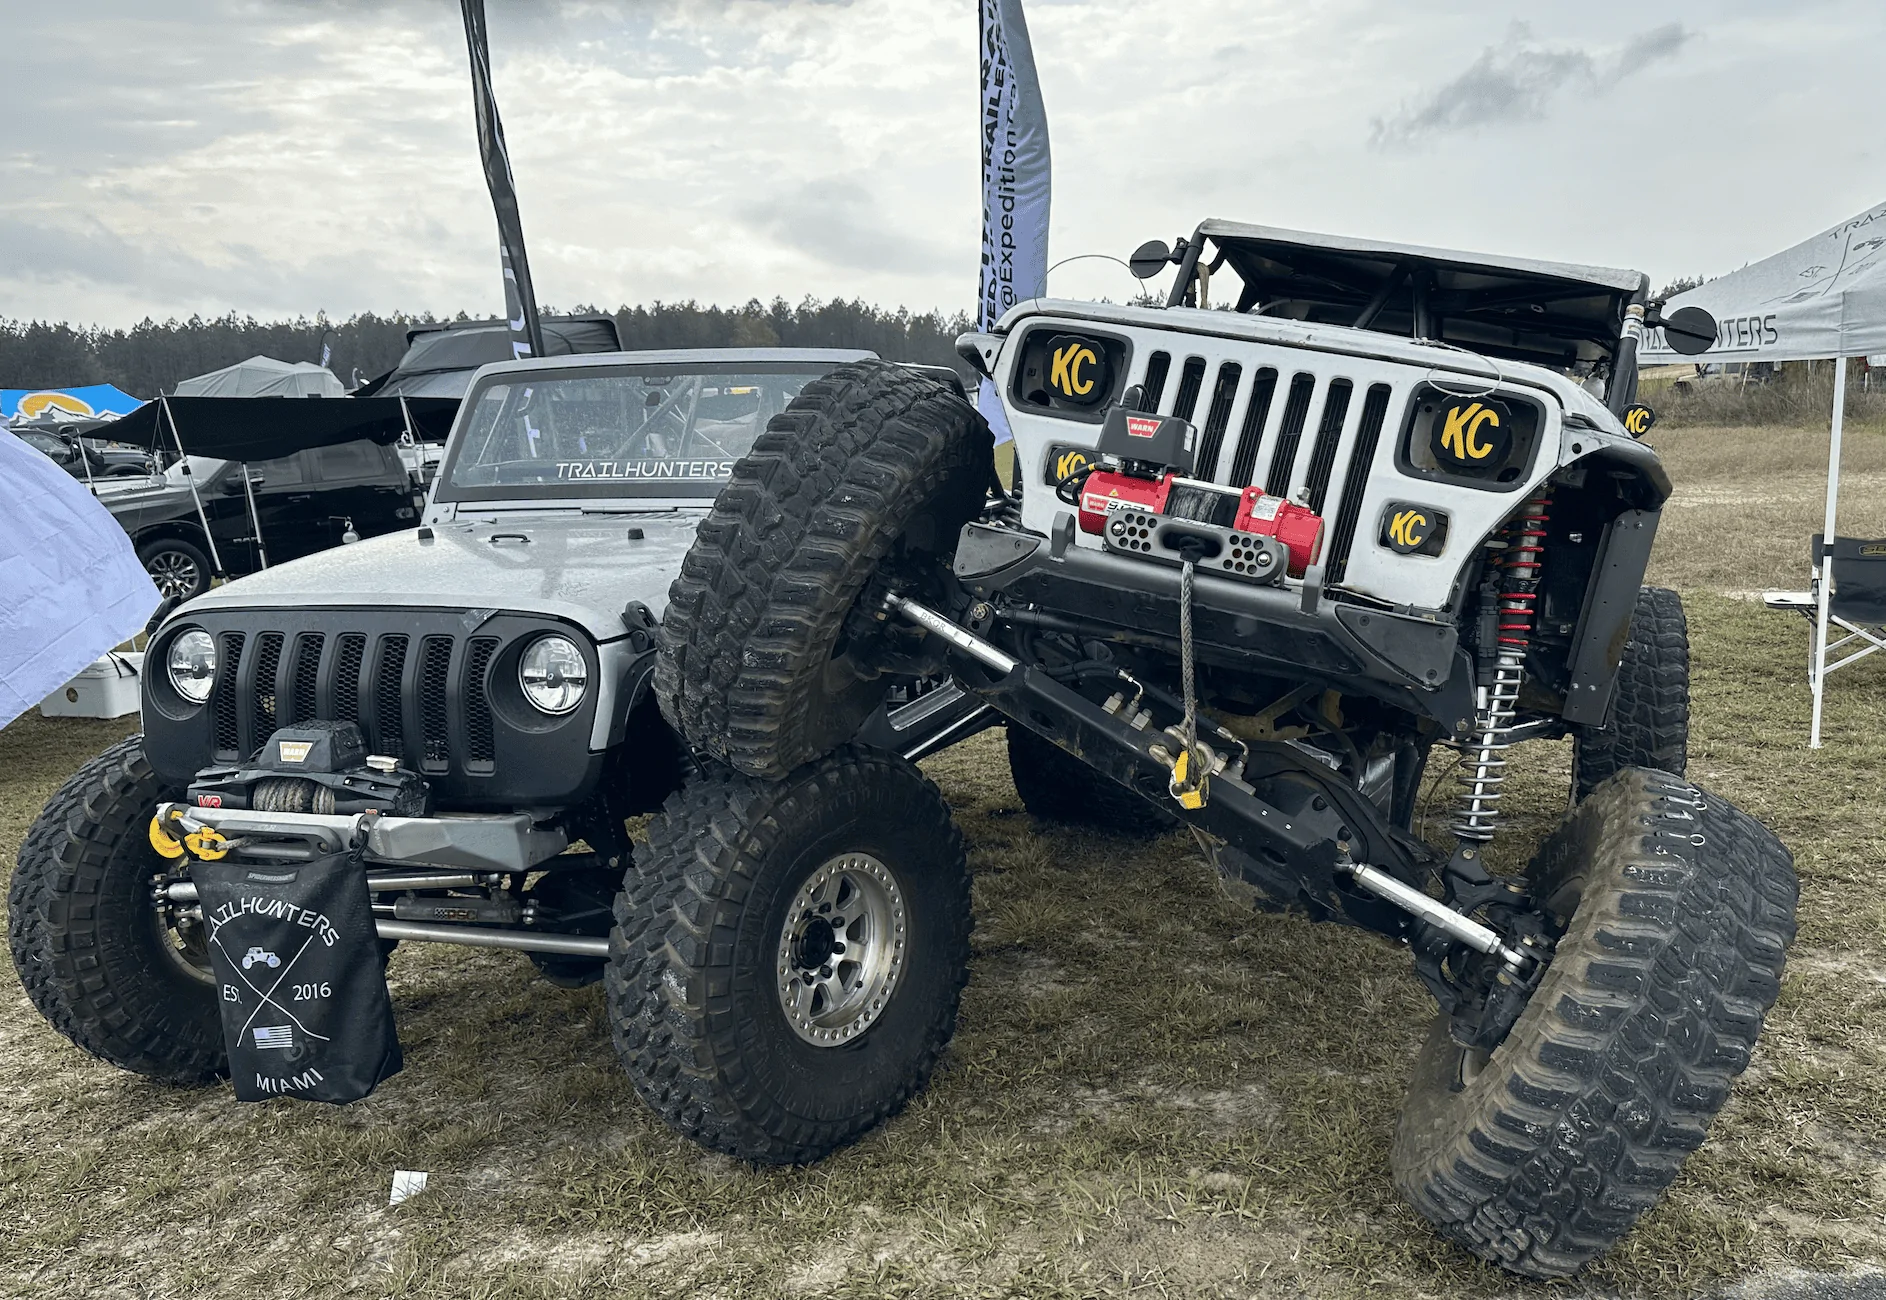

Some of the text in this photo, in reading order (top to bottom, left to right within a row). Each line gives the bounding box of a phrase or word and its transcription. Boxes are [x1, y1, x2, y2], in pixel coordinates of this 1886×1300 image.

[1050, 343, 1097, 397] KC
[1130, 423, 1154, 433] WARN
[1440, 402, 1500, 460] KC
[1624, 407, 1650, 434] KC
[556, 461, 735, 479] TRAILHUNTERS
[1056, 451, 1087, 480] KC
[1389, 509, 1427, 546] KC
[283, 746, 306, 756] WARN
[197, 794, 222, 809] VR
[208, 896, 341, 948] AILHUNTERS
[292, 981, 332, 1001] 2016
[256, 1067, 324, 1094] MIAMI
